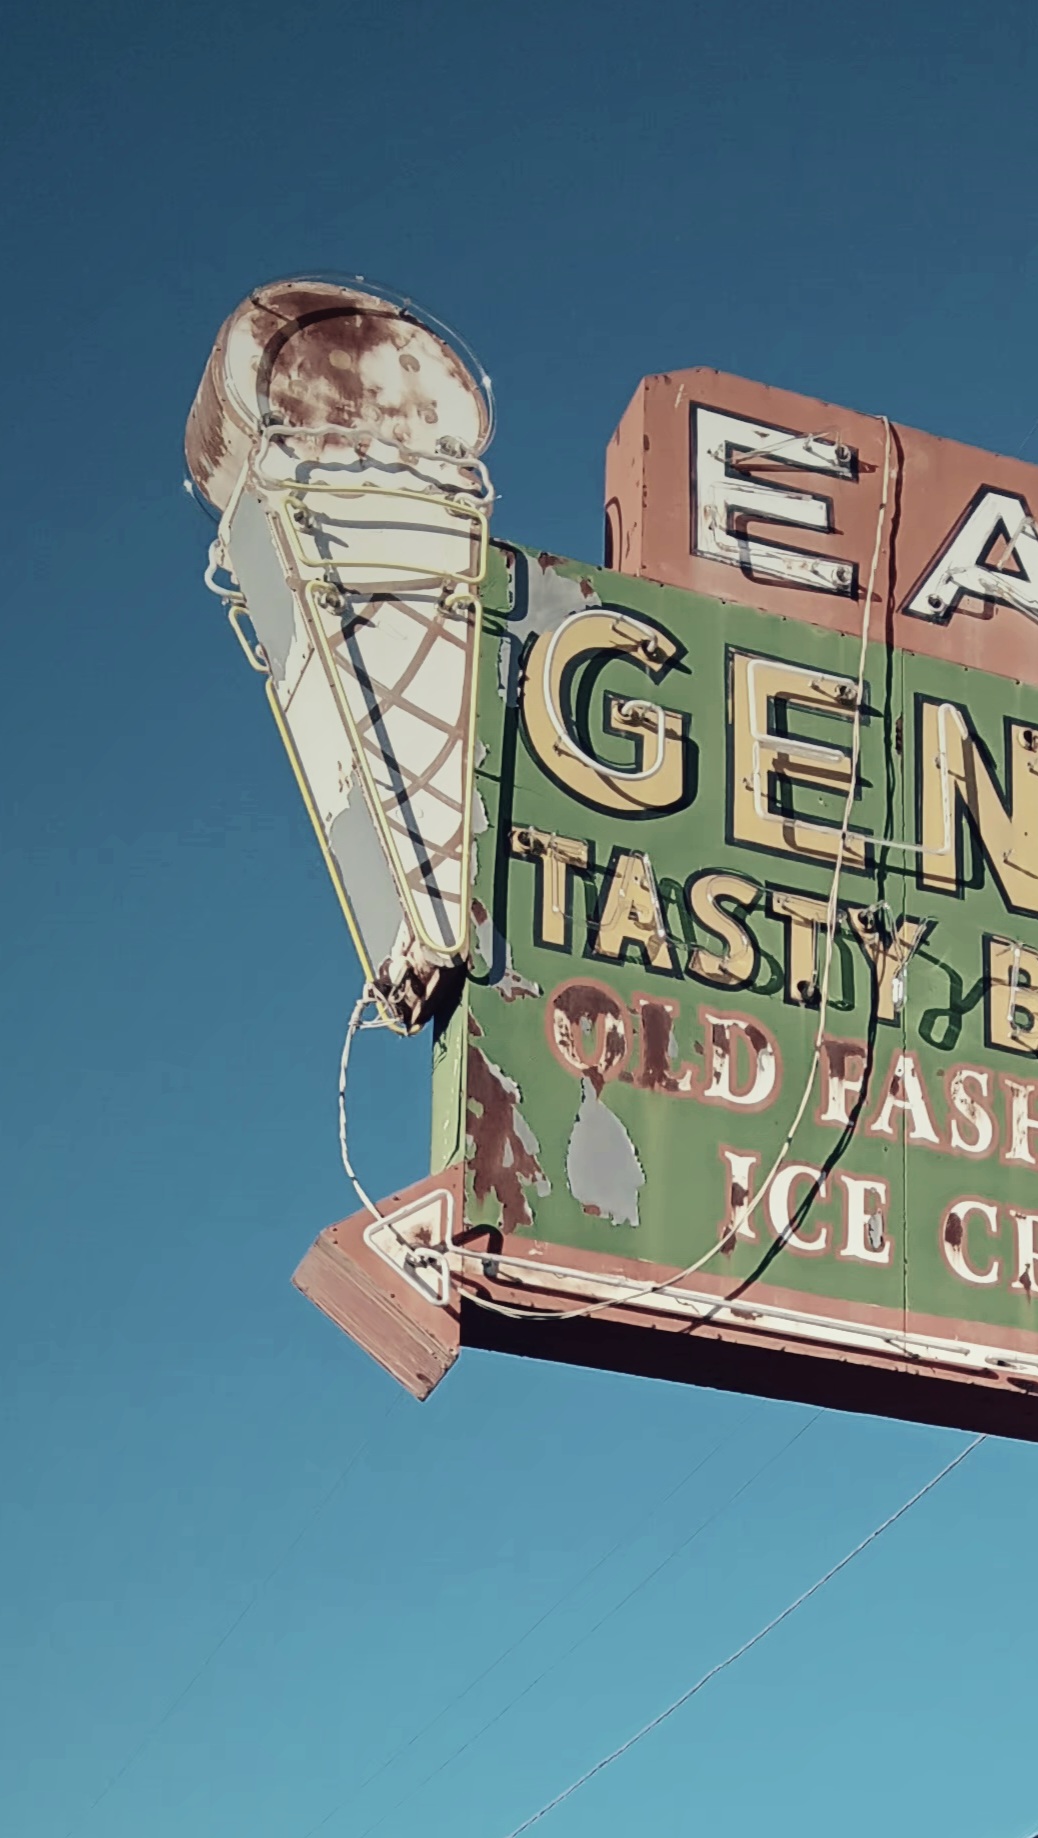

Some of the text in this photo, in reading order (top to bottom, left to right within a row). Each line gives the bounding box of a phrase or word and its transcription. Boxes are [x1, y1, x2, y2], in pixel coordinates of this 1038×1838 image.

[507, 823, 936, 1028] TASTY
[550, 982, 780, 1107] OLD
[721, 1149, 893, 1264] ICE
